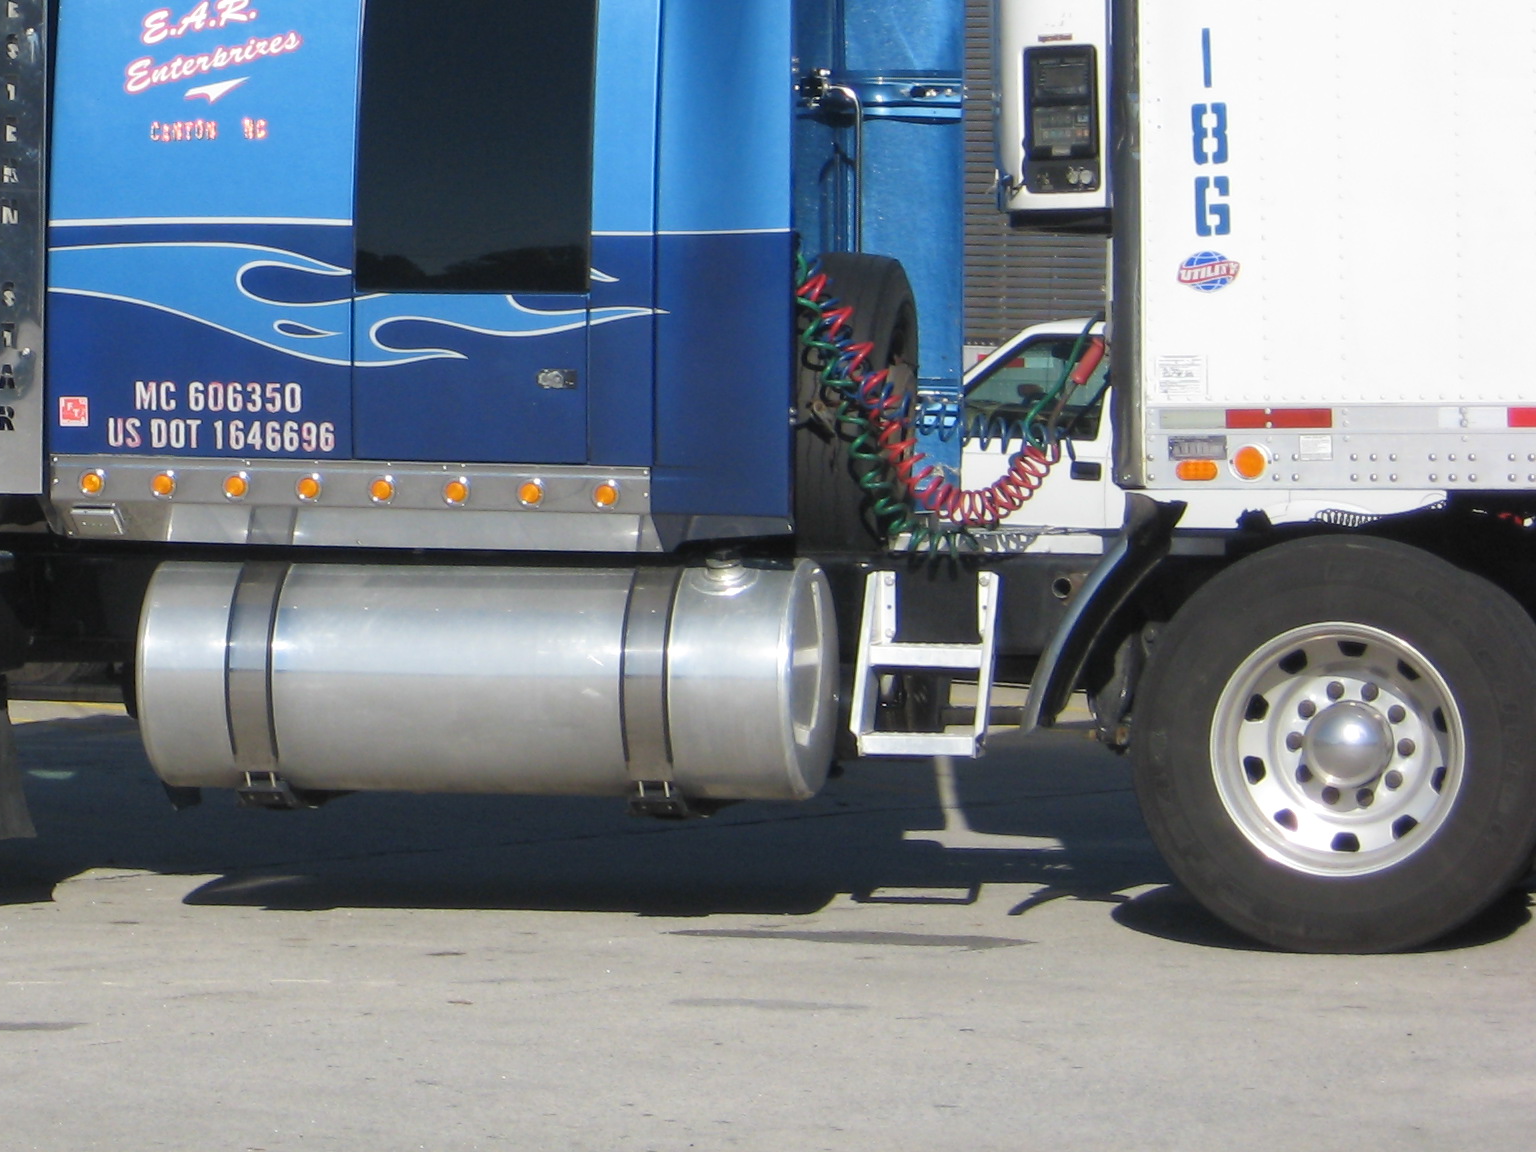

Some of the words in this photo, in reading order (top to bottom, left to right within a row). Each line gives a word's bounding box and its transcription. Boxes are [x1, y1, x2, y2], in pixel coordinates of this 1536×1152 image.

[242, 117, 269, 140] NC
[1179, 261, 1240, 282] UTILITY
[134, 381, 177, 411] MC
[188, 381, 302, 414] 606350
[108, 417, 142, 448] US
[150, 418, 202, 449] DOT
[214, 419, 335, 453] 1646696
